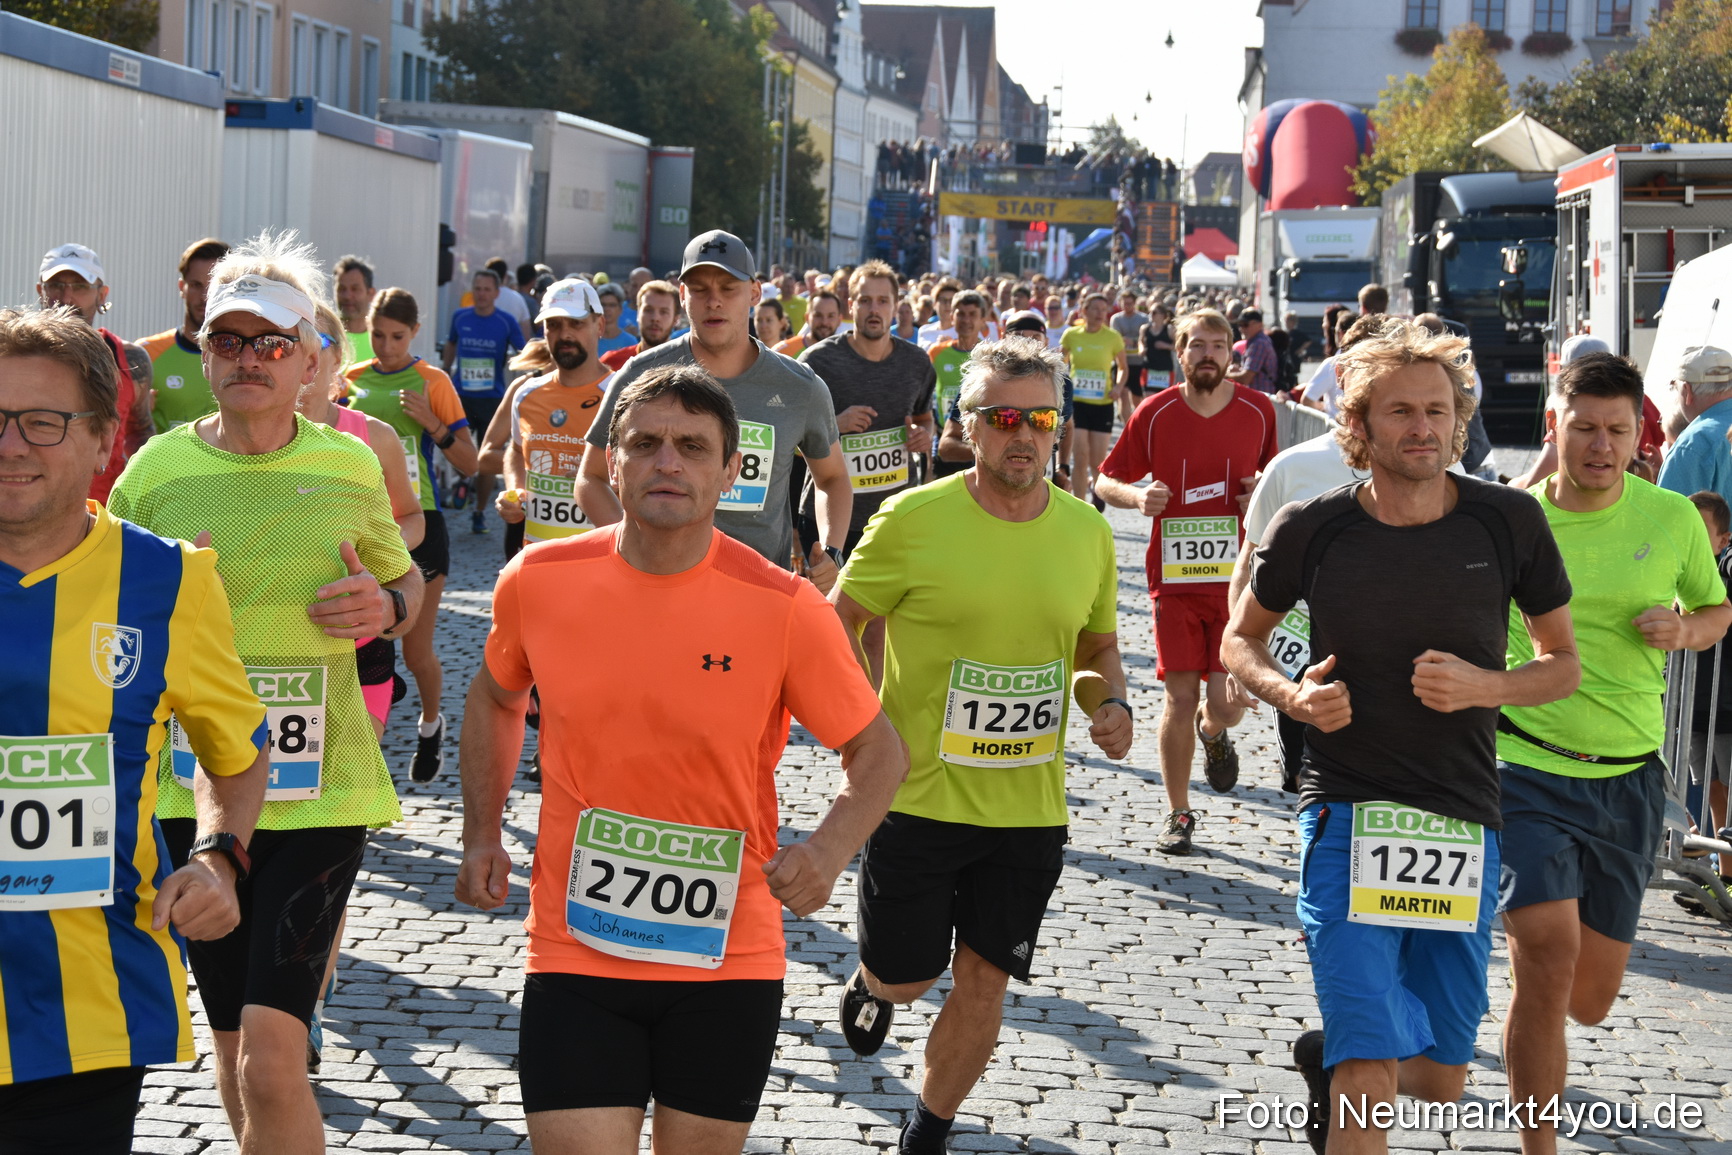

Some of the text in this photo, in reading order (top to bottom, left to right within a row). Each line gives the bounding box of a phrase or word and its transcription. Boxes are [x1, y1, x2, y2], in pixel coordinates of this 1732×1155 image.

[997, 200, 1056, 217] START
[1076, 379, 1101, 389] 2211
[524, 432, 587, 446] portSchec
[845, 431, 904, 450] BOCK
[851, 449, 903, 473] 1008
[529, 474, 575, 496] BOC
[859, 473, 897, 487] STEFAN
[531, 498, 587, 525] 1360
[1167, 519, 1232, 536] BOCK
[1171, 540, 1229, 560] 1307
[1181, 566, 1219, 575] SIMON
[1268, 631, 1303, 665] 18
[959, 664, 1058, 694] BOCK
[962, 699, 1053, 733] 1226
[972, 742, 1035, 756] HORST
[0, 798, 84, 851] 01
[1363, 806, 1475, 841] BOCK
[587, 812, 730, 868] BOCK
[1370, 845, 1468, 887] 1227
[585, 859, 718, 919] 2700
[1379, 894, 1452, 915] MARTIN
[589, 912, 665, 944] Johannes
